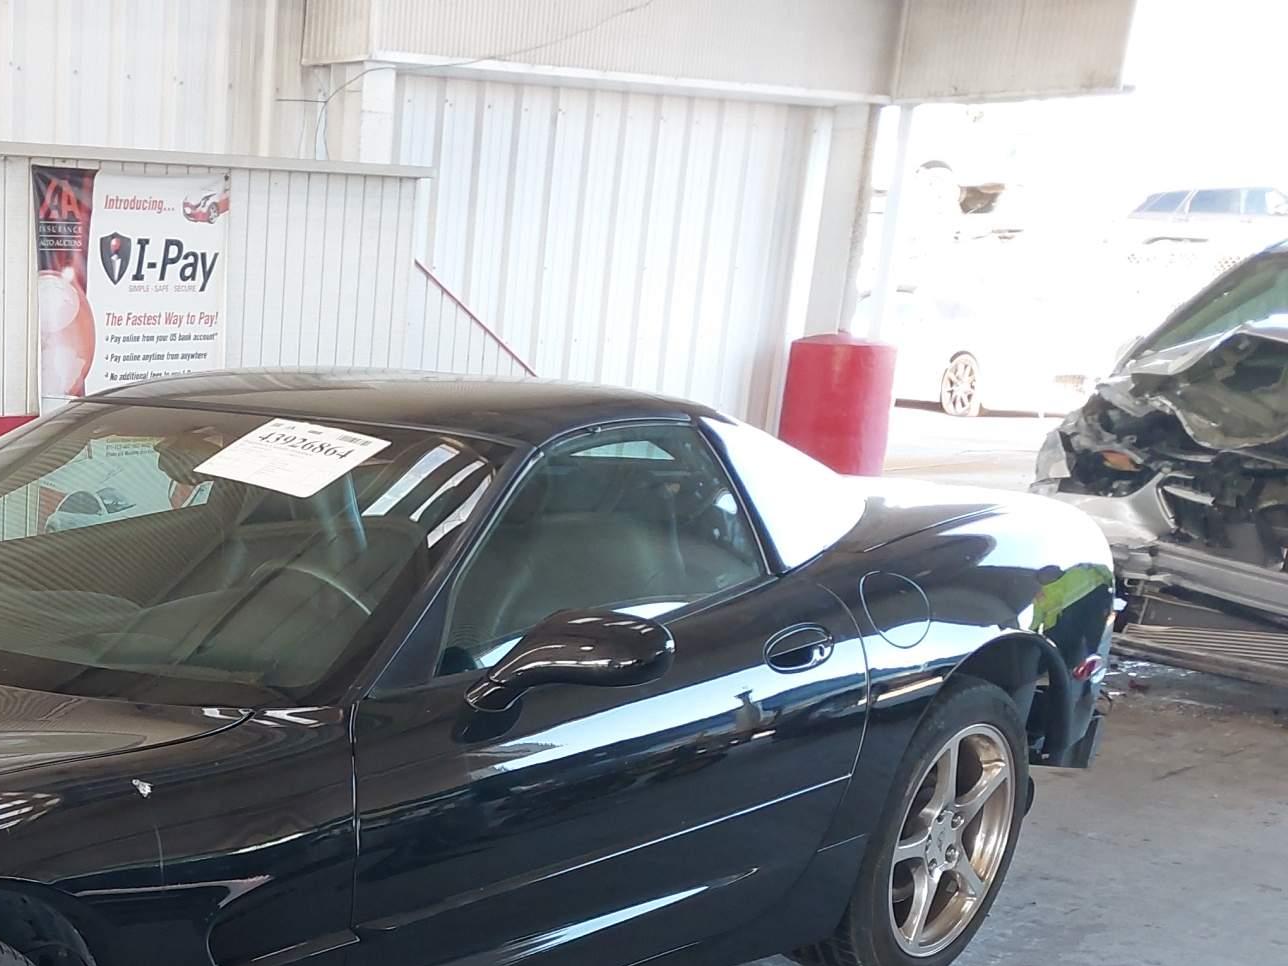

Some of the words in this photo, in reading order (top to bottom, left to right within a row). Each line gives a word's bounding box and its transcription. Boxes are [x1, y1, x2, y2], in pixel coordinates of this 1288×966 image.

[104, 195, 175, 213] Introducing...
[131, 238, 219, 292] I-Pay
[105, 312, 122, 326] The
[125, 312, 162, 326] Fastest
[164, 311, 184, 328] Way
[186, 311, 196, 325] to
[198, 311, 219, 327] Pay!
[110, 334, 121, 344] Pay
[122, 334, 140, 342] online
[141, 333, 155, 342] from
[156, 334, 168, 344] your
[178, 333, 191, 341] bank
[110, 353, 121, 363] Pay
[122, 353, 141, 361] online
[142, 352, 165, 362] anytime
[166, 352, 179, 360] from
[180, 352, 208, 361] anywhere
[110, 372, 118, 381] No
[119, 371, 148, 381] additional
[259, 432, 355, 459] 43926864
